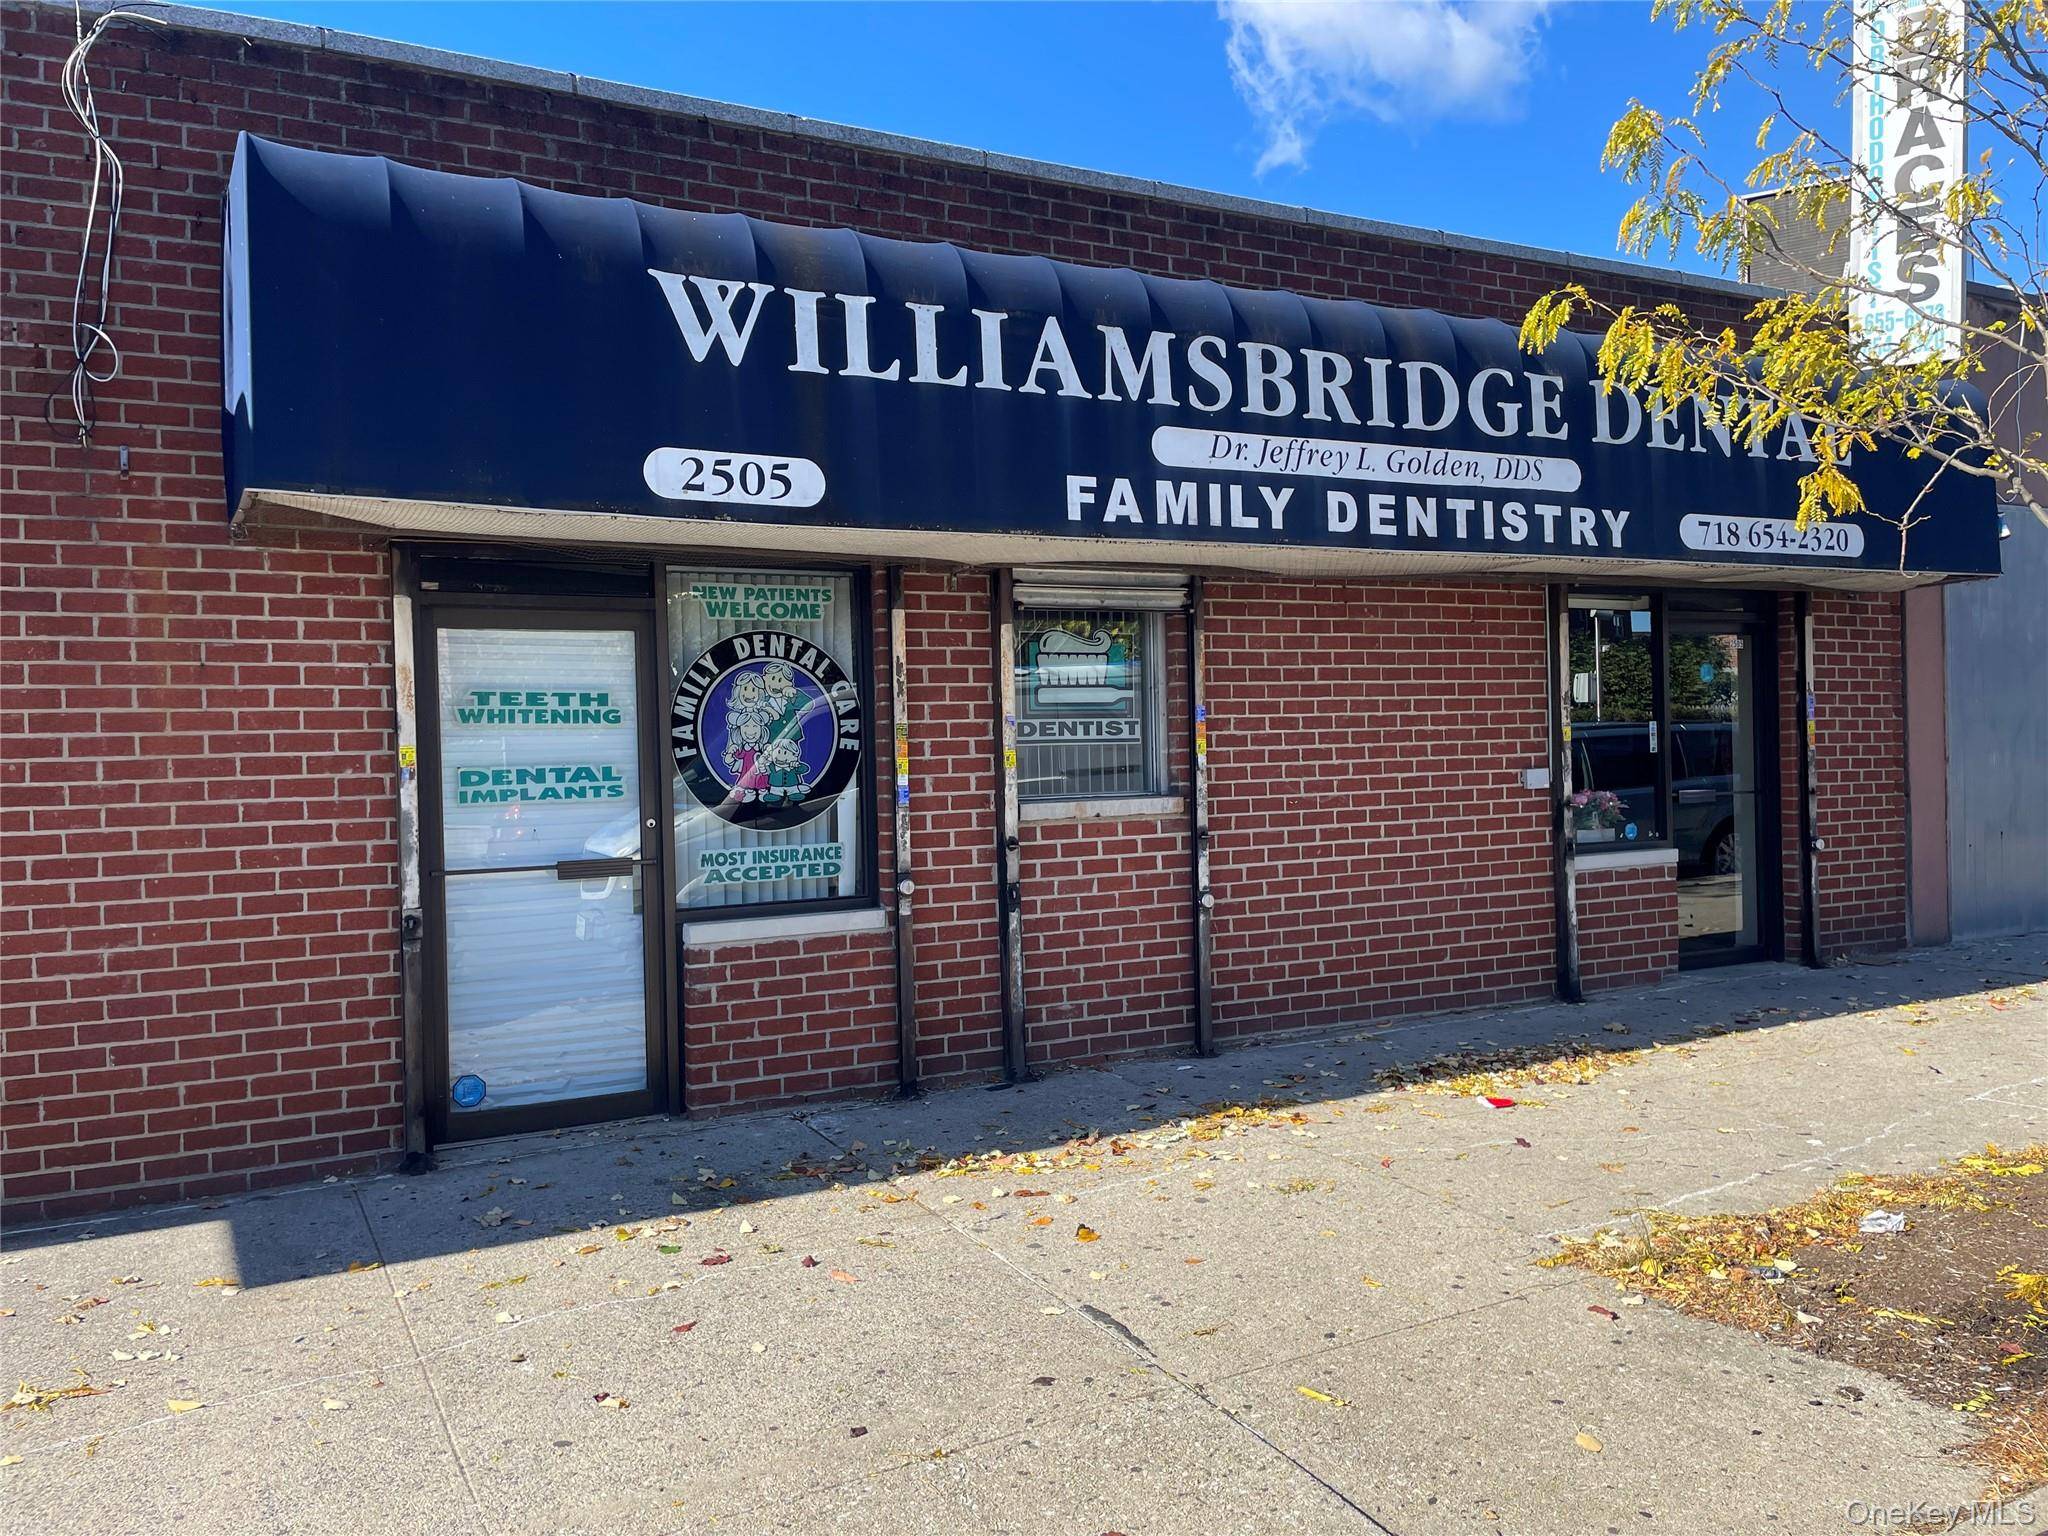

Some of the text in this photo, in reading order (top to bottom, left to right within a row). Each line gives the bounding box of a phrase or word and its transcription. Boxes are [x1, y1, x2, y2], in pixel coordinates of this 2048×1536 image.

[647, 268, 1569, 441] WILLIAMSBRIDGE
[1208, 433, 1543, 483] Dr. Jeffrey L. Golden, DDS
[680, 456, 793, 500] 2505
[1066, 474, 1631, 549] FAMILY DENTISTRY
[1697, 520, 1850, 552] 718 654-2320
[692, 585, 832, 602] NEW PATIENTS
[706, 602, 822, 619] WELCOME
[470, 691, 609, 706] TEETH
[671, 634, 860, 759] FAMILY DENTAL CARE
[457, 708, 622, 725] WHITENING
[1018, 720, 1139, 737] DENTIST
[459, 766, 623, 787] DENTAL
[458, 784, 625, 804] IMPLANTS
[700, 846, 842, 868] MOST INSURANCE
[703, 862, 842, 884] ACCEPTED
